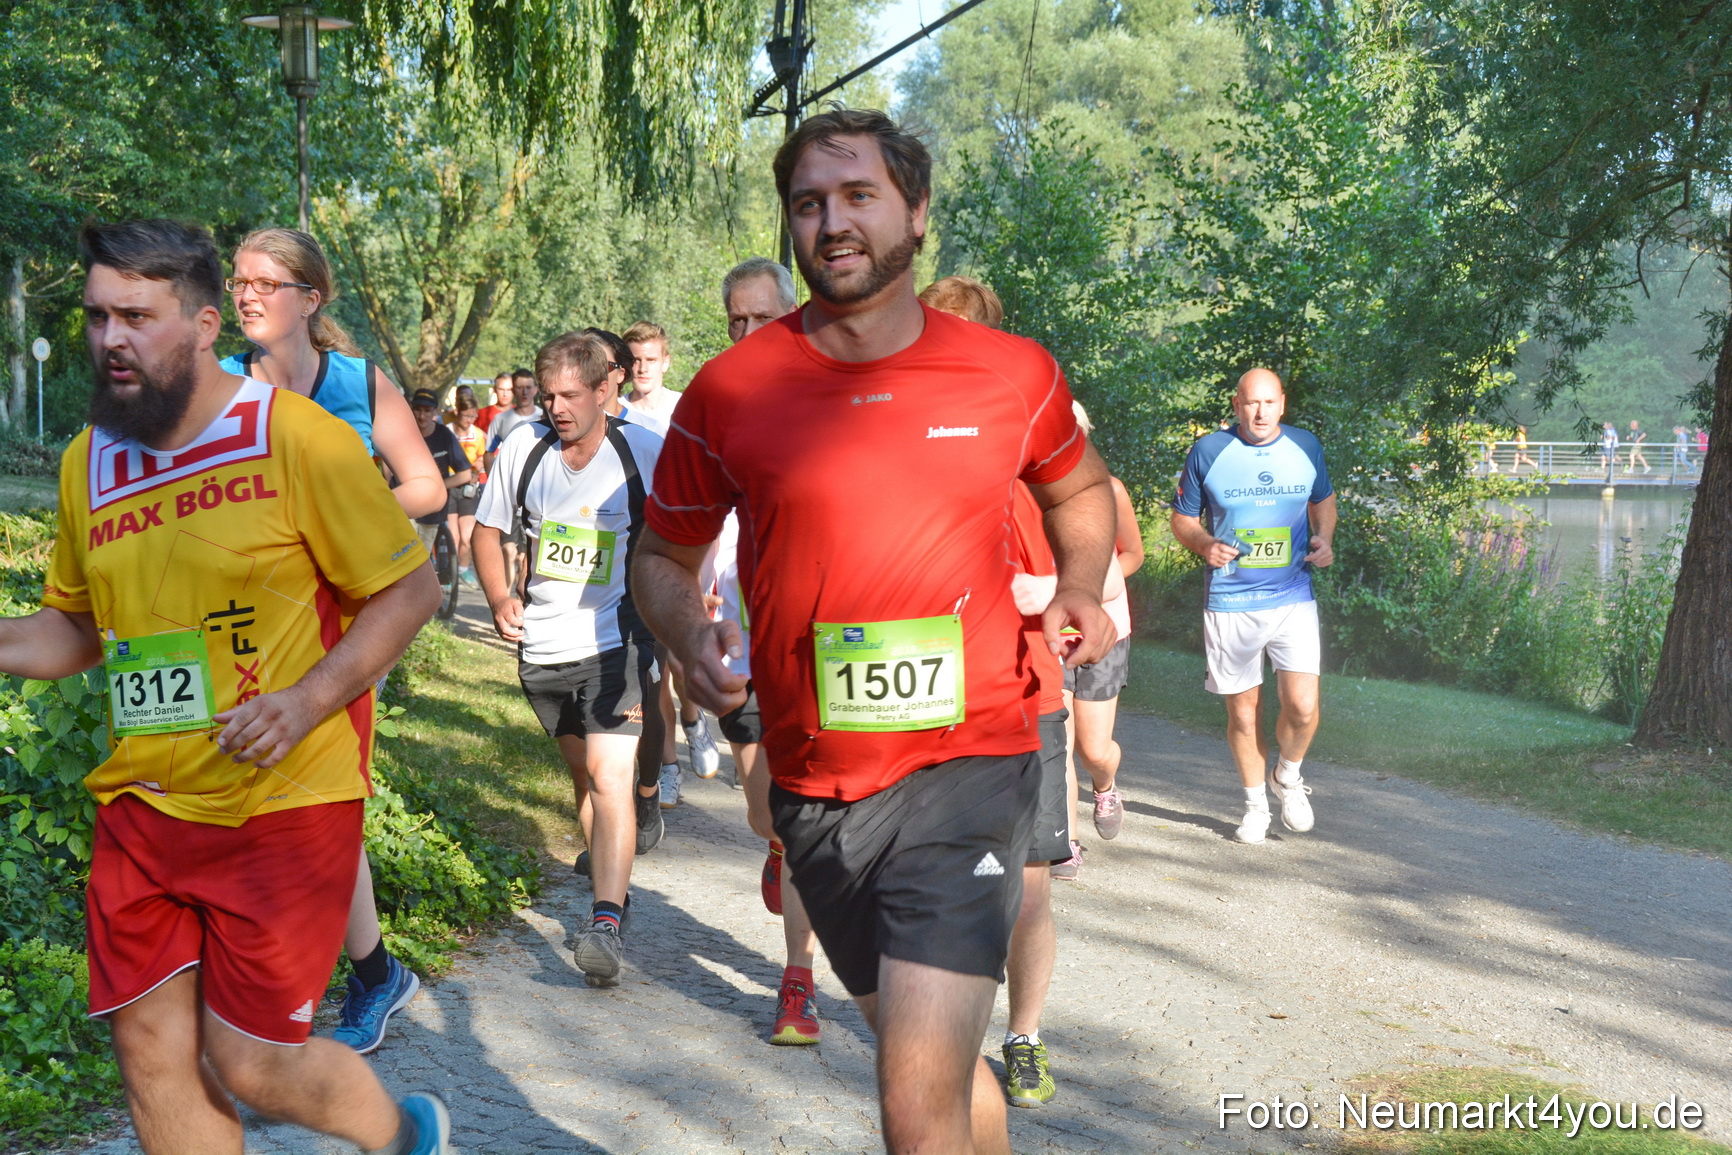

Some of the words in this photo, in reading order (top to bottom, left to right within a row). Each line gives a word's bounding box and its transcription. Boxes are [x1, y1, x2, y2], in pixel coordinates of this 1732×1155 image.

[865, 393, 893, 403] JAKO
[926, 426, 979, 438] Johannes
[1224, 485, 1307, 499] SCHABMÜLLER
[1255, 499, 1277, 508] TEAM
[89, 501, 164, 552] MAX
[175, 474, 279, 519] BÖGL
[546, 542, 604, 569] 2014
[1247, 541, 1285, 558] 767
[836, 657, 944, 701] 1507
[114, 667, 195, 708] 1312
[123, 706, 153, 719] Rechter
[154, 704, 184, 716] Daniel
[828, 702, 901, 713] Grabenbauer
[904, 697, 955, 712] Johannes
[127, 718, 138, 727] Bögl
[139, 715, 173, 725] Bauservice
[173, 713, 195, 721] GmbH
[876, 713, 897, 722] Petry
[898, 712, 910, 720] AG
